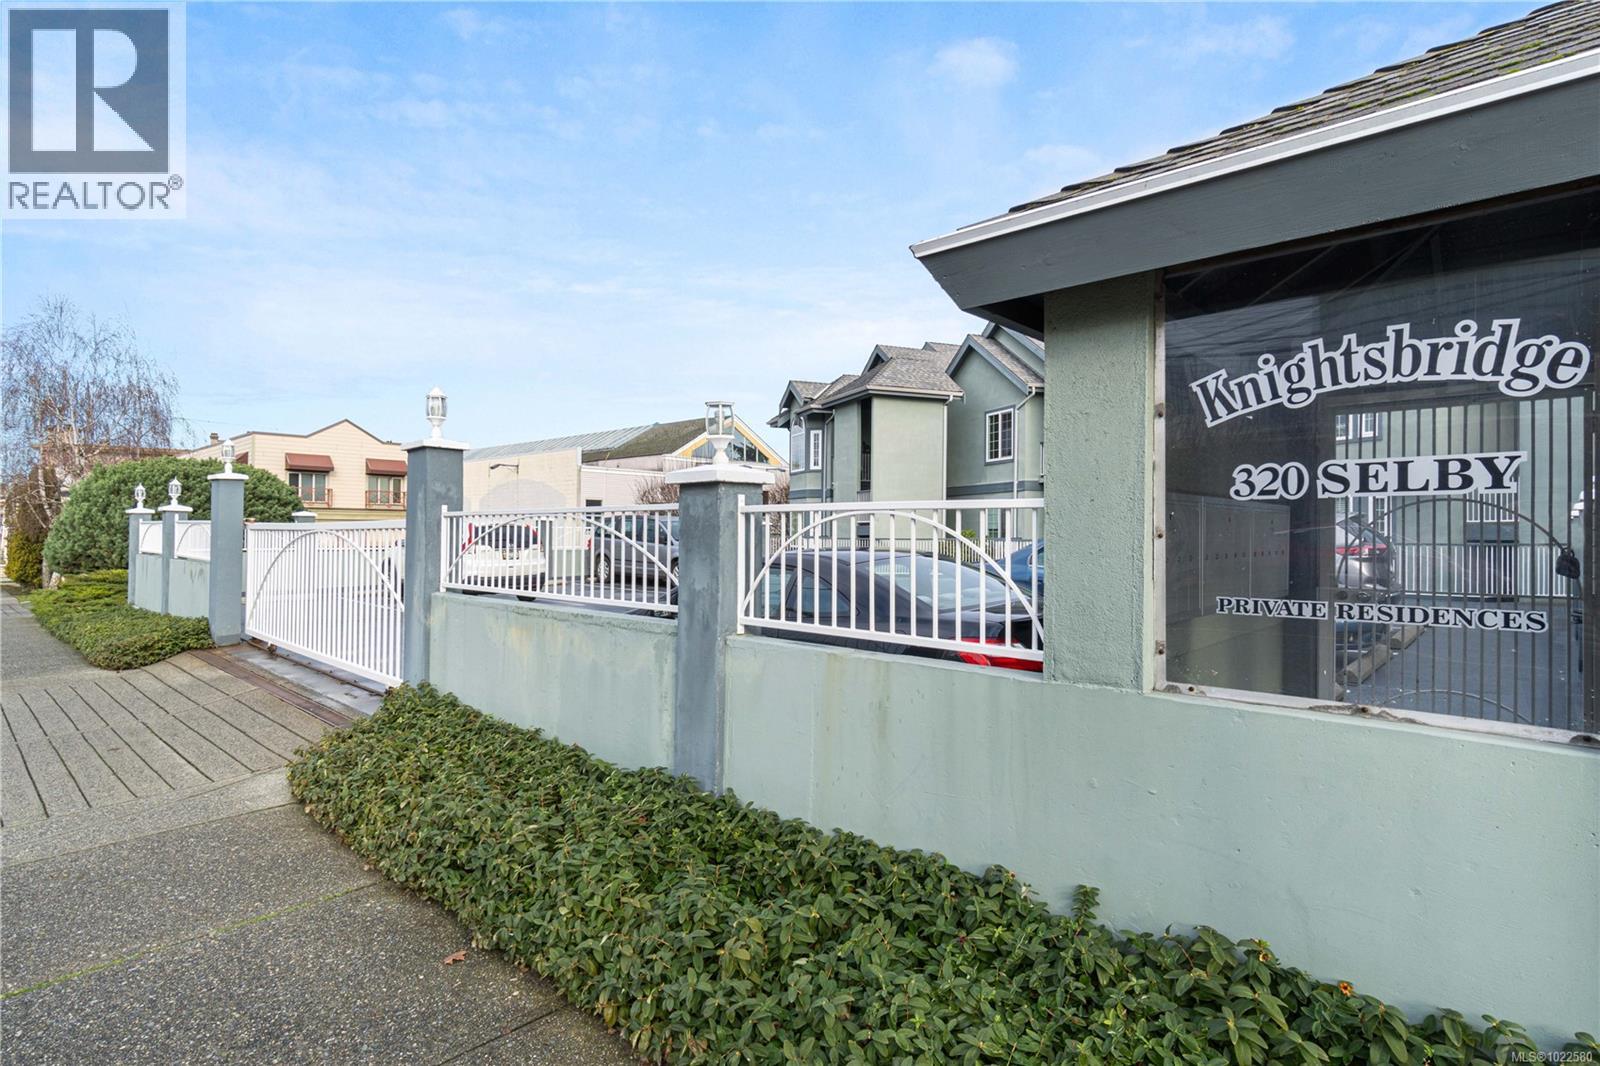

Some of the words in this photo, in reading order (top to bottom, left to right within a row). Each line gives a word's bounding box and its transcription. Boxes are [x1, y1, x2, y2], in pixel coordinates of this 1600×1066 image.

[1190, 318, 1591, 426] Knightsbridge
[1230, 462, 1309, 500] 320
[1317, 451, 1527, 499] SELBY
[1217, 596, 1328, 620] PRIVATE
[1334, 601, 1548, 632] RESIDENCES
